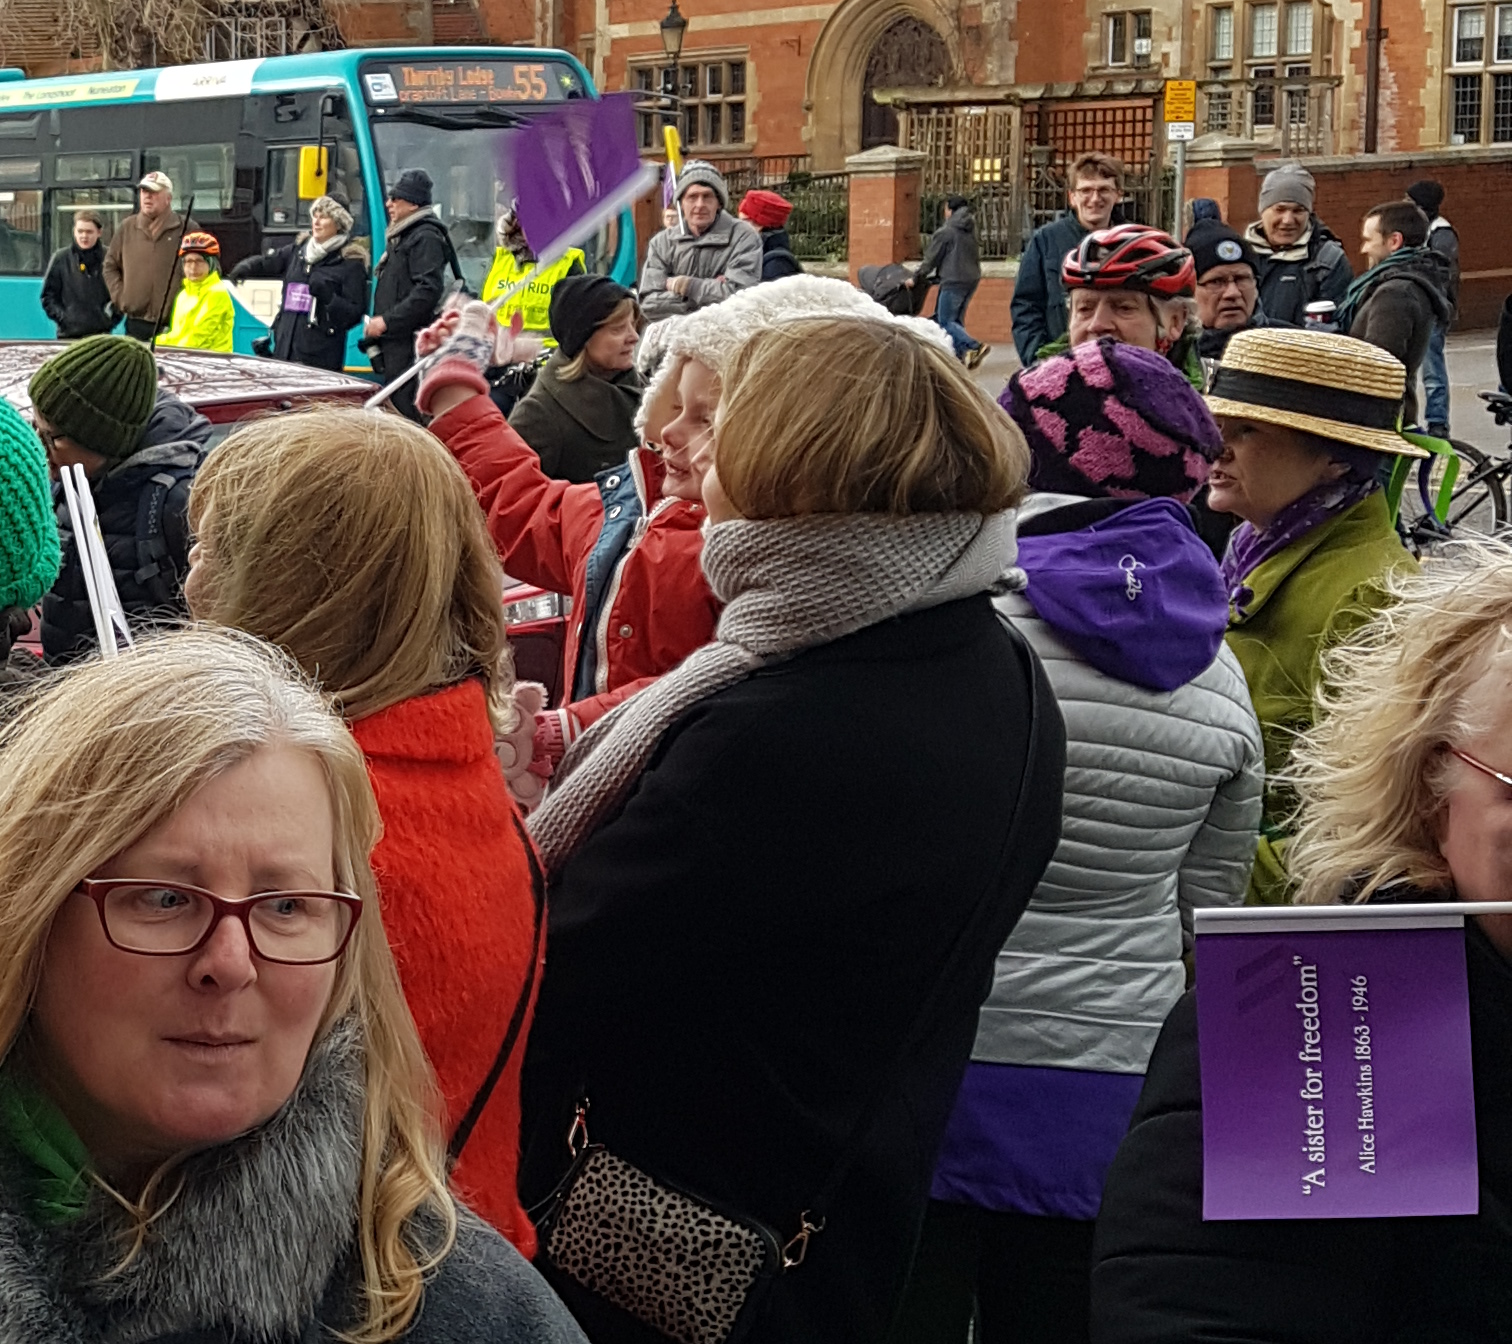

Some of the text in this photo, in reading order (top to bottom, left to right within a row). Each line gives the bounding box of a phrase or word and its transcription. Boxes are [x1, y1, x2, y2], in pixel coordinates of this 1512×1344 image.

[513, 64, 548, 100] 55
[528, 281, 553, 295] RID
[1350, 975, 1369, 1012] 1946
[1354, 1024, 1371, 1060] 1863
[1293, 955, 1326, 1196] “A sister for freedom”
[1356, 1064, 1374, 1131] Hawkins
[1358, 1132, 1376, 1175] Alice
